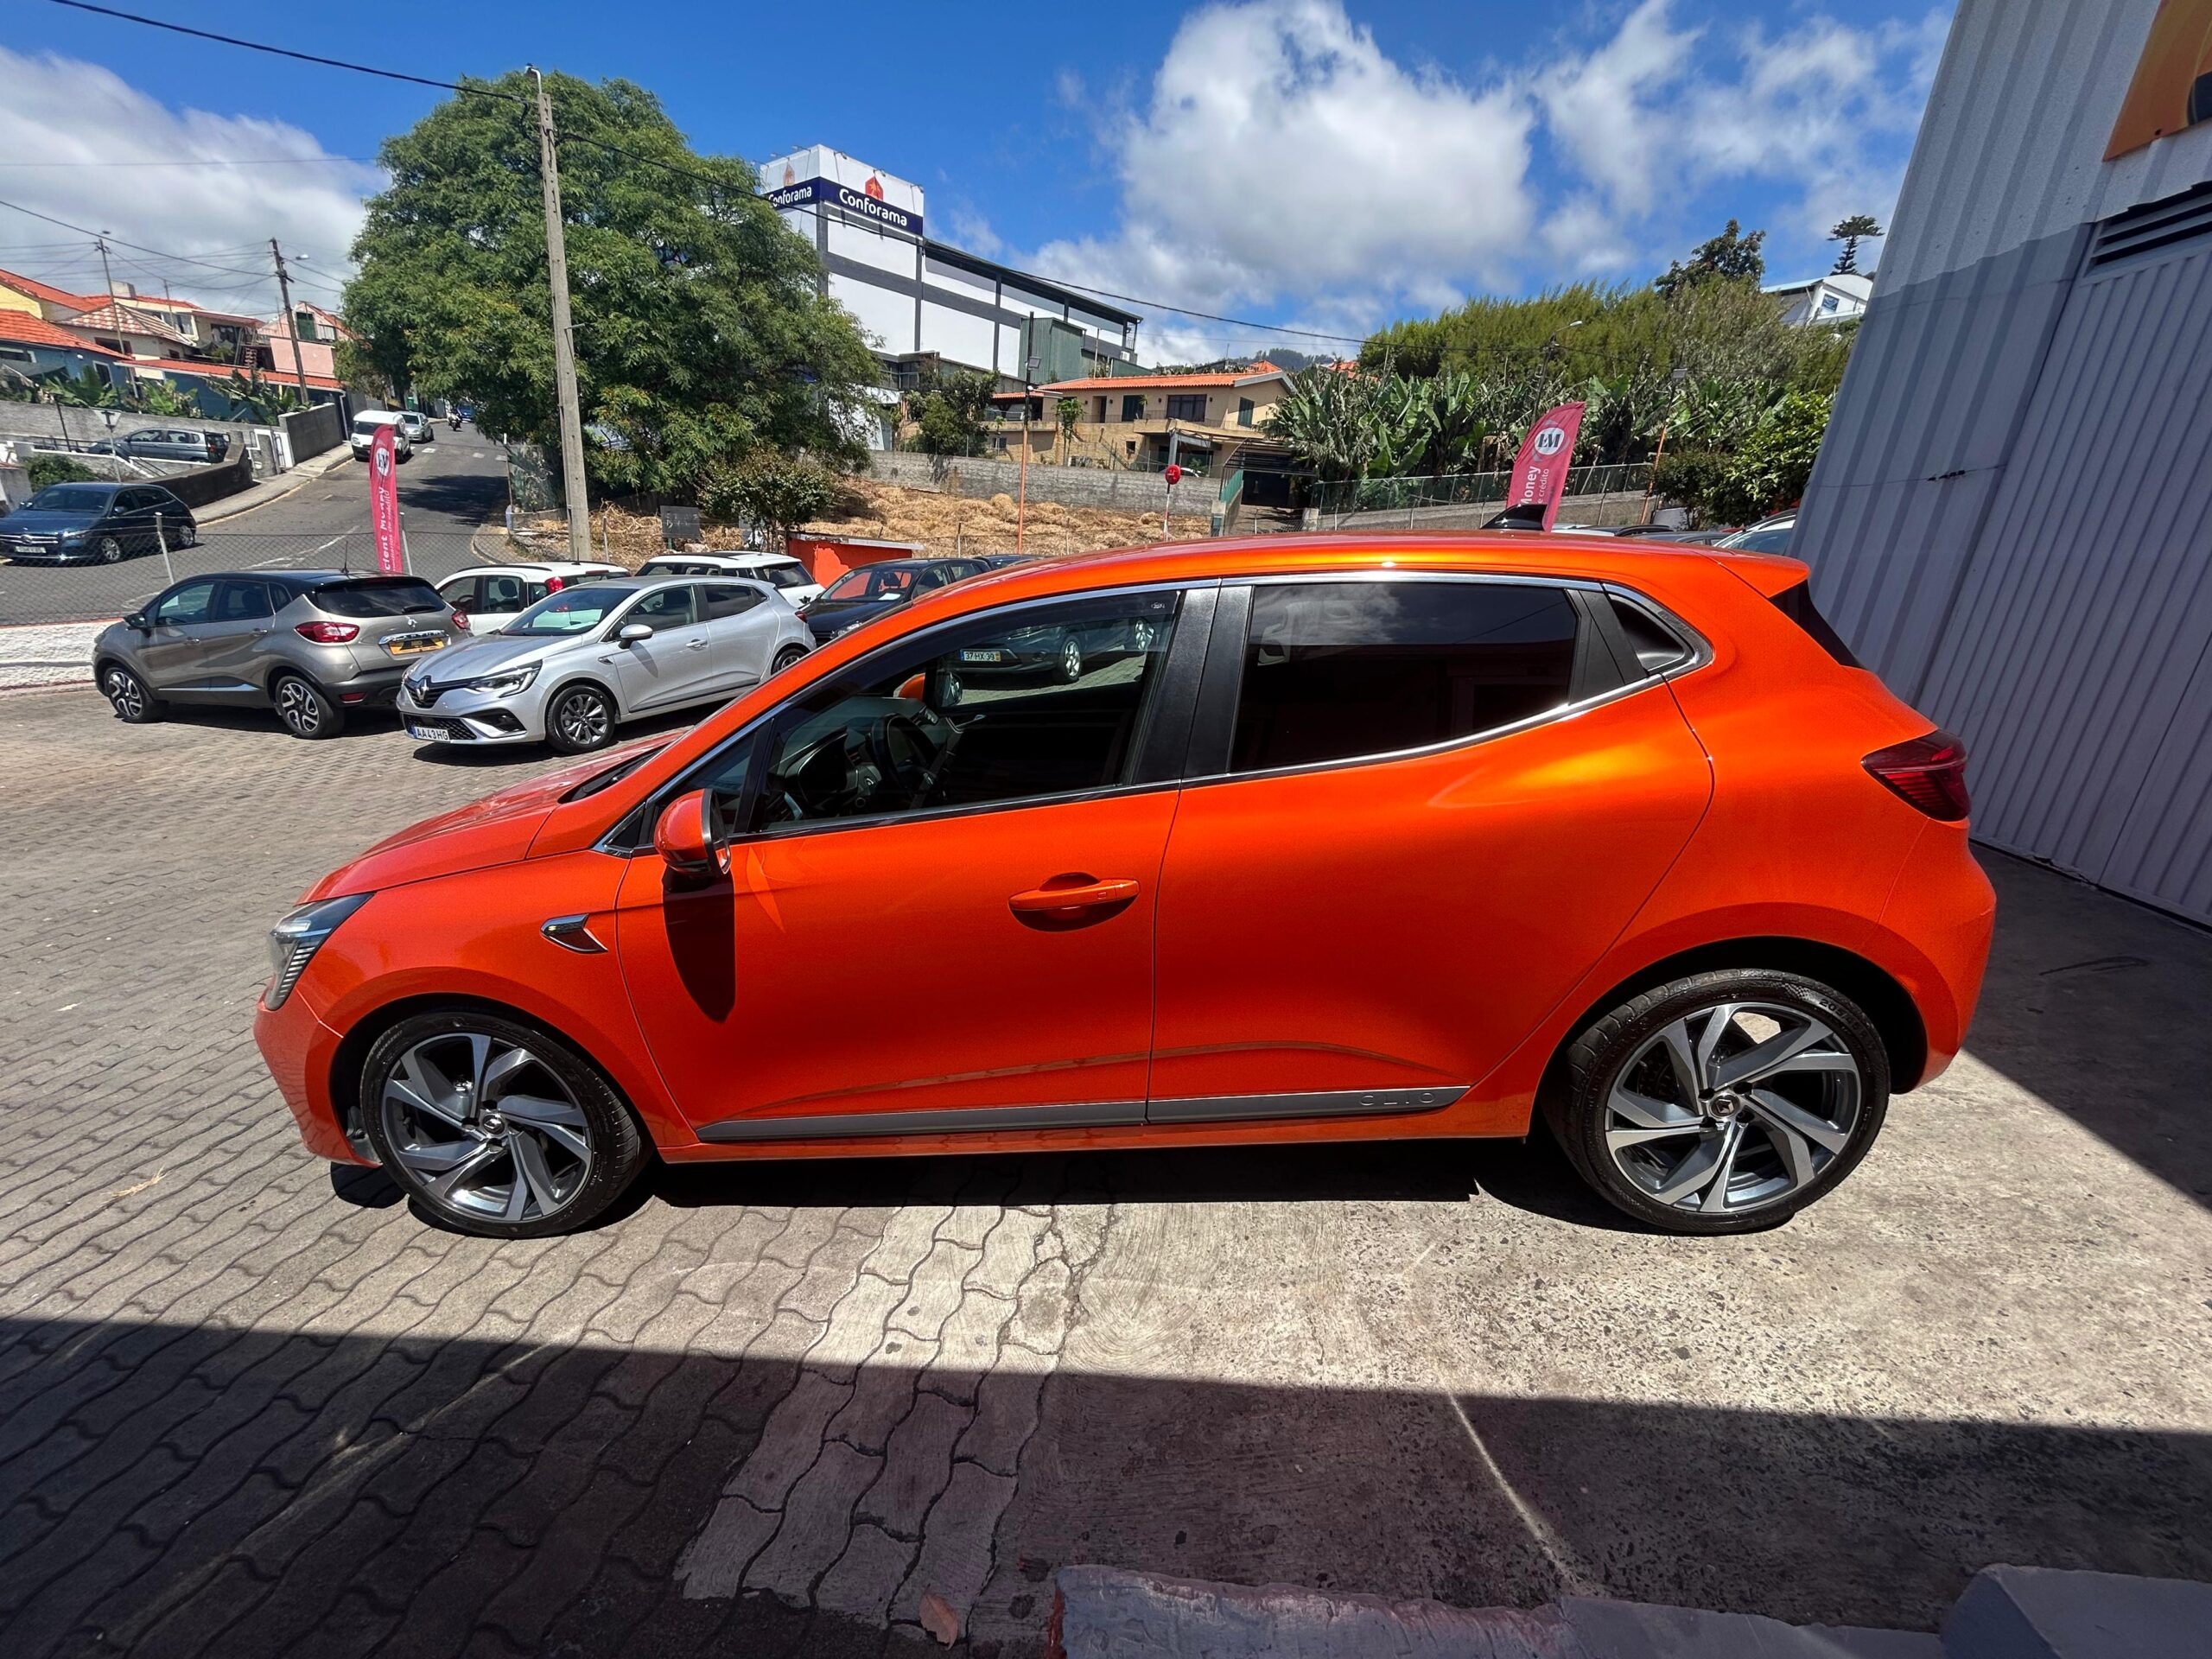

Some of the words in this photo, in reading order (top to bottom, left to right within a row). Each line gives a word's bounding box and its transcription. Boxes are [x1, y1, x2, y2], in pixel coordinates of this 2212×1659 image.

[768, 186, 812, 207] Conforama
[839, 188, 907, 226] Conforama
[1520, 466, 1541, 505] Money
[1539, 468, 1549, 497] crédito
[1359, 1092, 1435, 1106] CLIO
